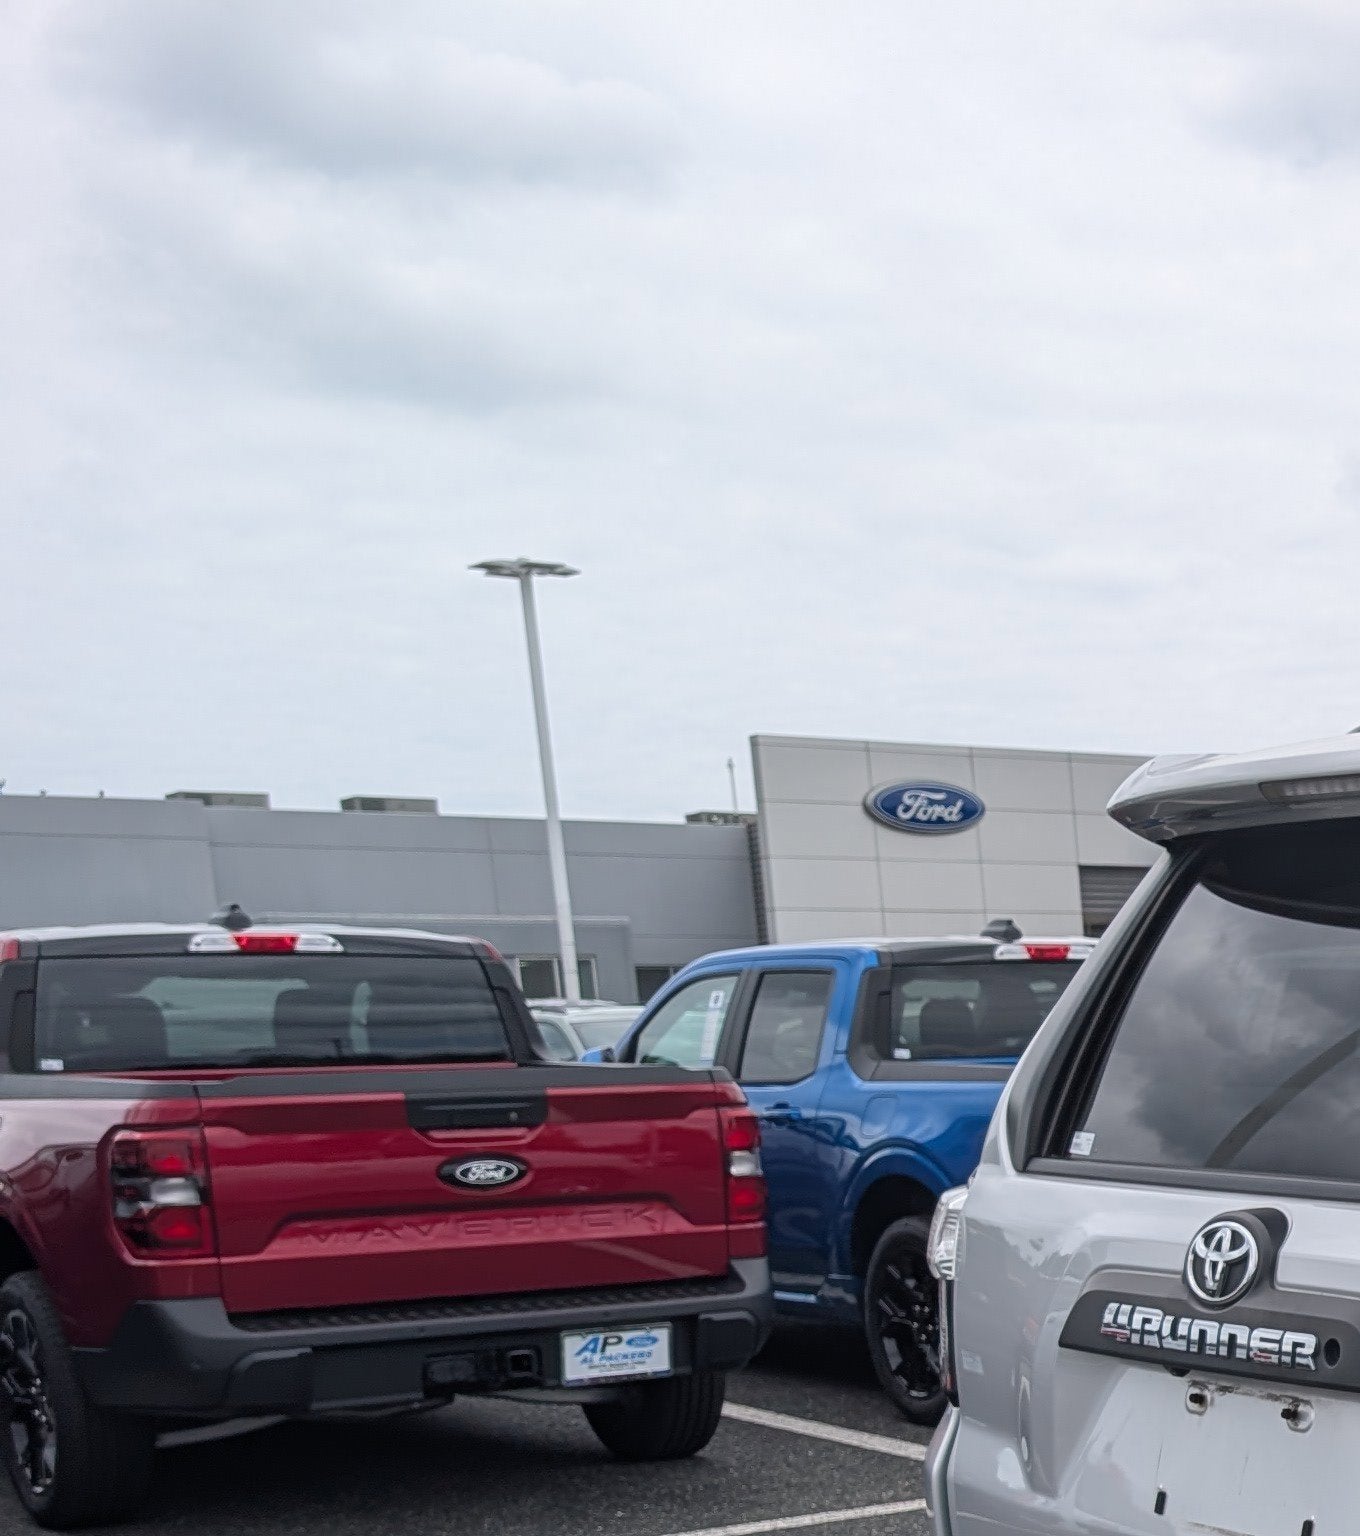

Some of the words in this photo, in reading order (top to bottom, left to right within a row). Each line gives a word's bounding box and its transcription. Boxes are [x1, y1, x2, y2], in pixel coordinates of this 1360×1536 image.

[895, 788, 963, 823] Ford
[466, 1162, 508, 1182] Ford
[298, 1204, 667, 1247] MAVERICK
[574, 1334, 623, 1357] AP
